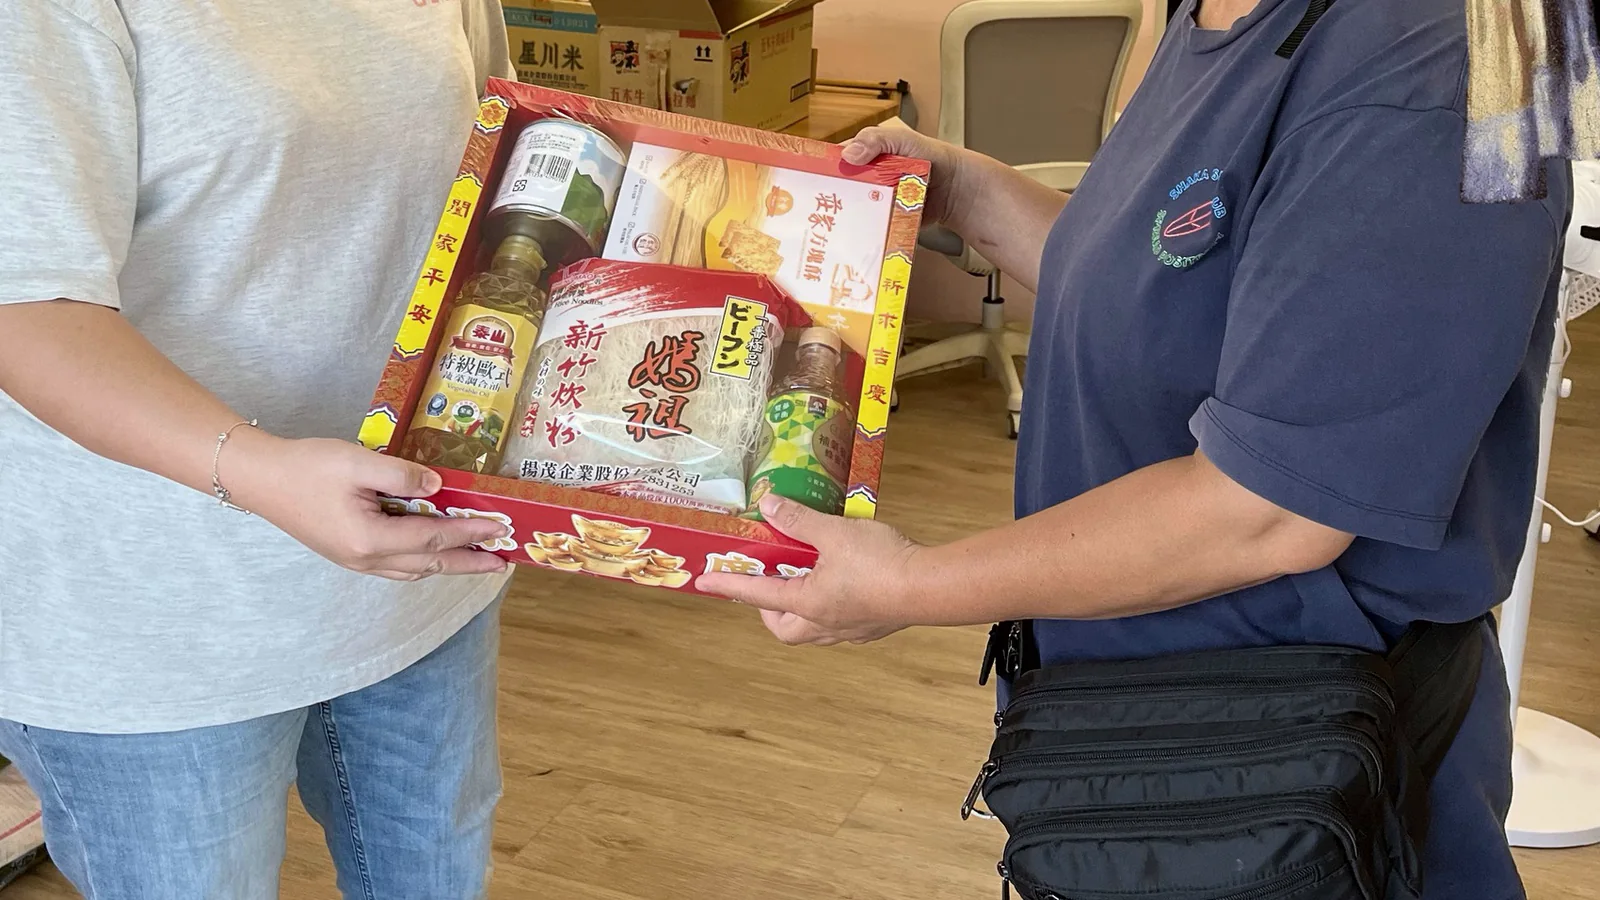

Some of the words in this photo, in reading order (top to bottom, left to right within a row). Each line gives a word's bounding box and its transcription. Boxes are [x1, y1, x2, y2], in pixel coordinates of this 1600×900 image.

[518, 39, 584, 72] 星川米
[472, 324, 506, 343] 泰山
[717, 303, 751, 369] ビーフン
[745, 314, 769, 368] 一番極品
[864, 277, 905, 405] 祈求吉慶
[440, 352, 513, 388] 特級歐式
[447, 383, 479, 395] Vegetable
[545, 319, 608, 448] 新竹炊粉
[622, 330, 705, 442] 媽祖
